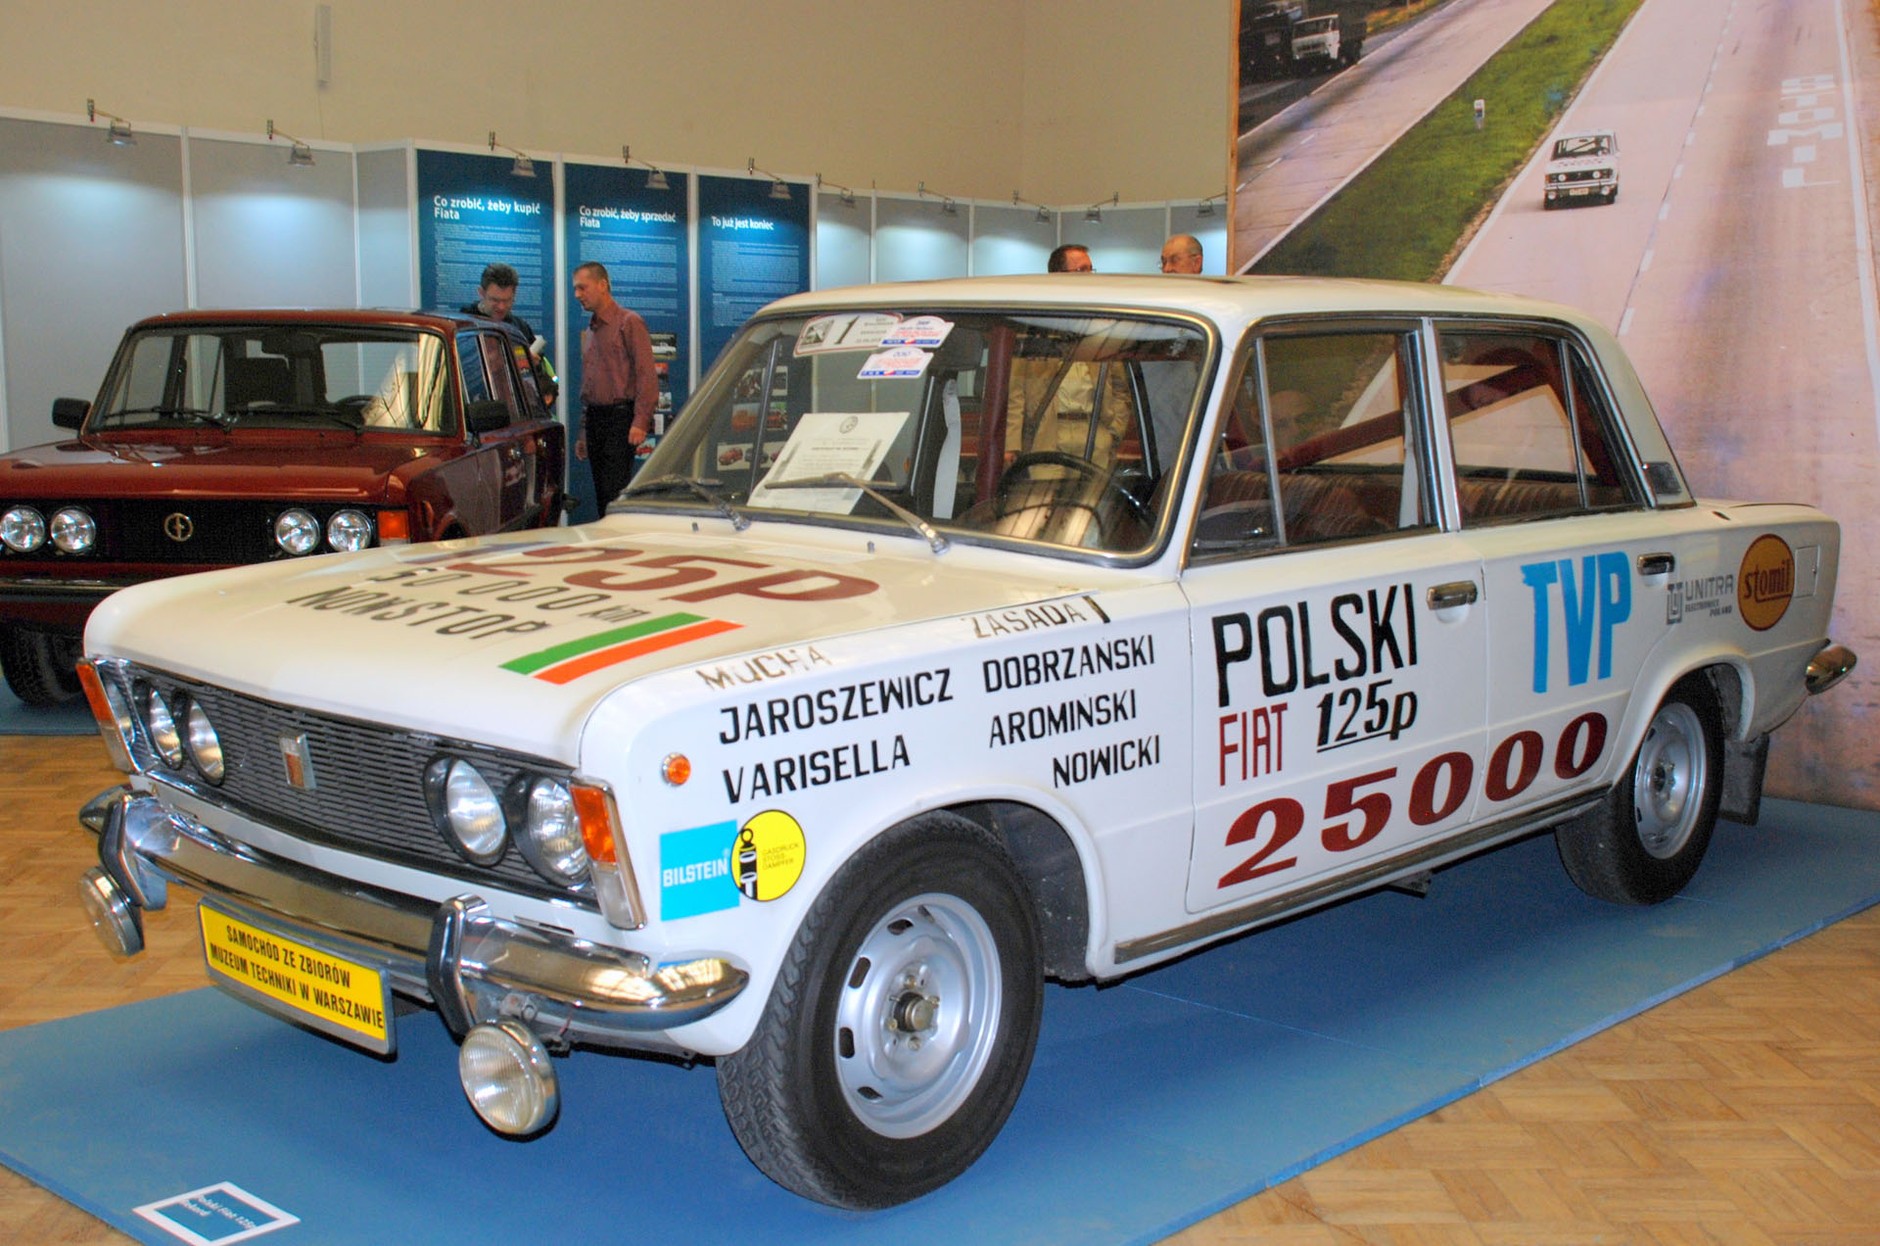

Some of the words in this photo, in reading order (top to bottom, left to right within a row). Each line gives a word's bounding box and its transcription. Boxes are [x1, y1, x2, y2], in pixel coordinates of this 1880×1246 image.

[433, 195, 448, 207] Co
[487, 200, 512, 215] żeby
[513, 201, 541, 216] kupić
[433, 206, 460, 220] Fiata
[580, 205, 591, 217] Co
[620, 208, 640, 223] żeby
[641, 211, 677, 223] sprzedać
[580, 216, 601, 229] Fiata
[711, 215, 722, 227] To
[734, 217, 749, 231] jest
[749, 217, 774, 231] koniec
[285, 586, 550, 640] NONSTOP
[1685, 574, 1734, 600] UNITRA
[968, 602, 1087, 638] ZASADA
[1212, 583, 1418, 708] POLSKI
[1520, 551, 1632, 694] TVP
[697, 645, 833, 691] MUCHA
[719, 667, 954, 745] JAROSZEWICZ
[1317, 679, 1418, 746] 125p
[722, 734, 911, 804] VARISELLA
[1053, 735, 1161, 789] NOWICKI
[1219, 702, 1288, 786] FIAT
[1217, 711, 1608, 889] 25000
[663, 857, 728, 888] BILSTEIN
[226, 924, 280, 962] SAMOCHÓD
[283, 948, 297, 969] ZE
[299, 954, 351, 989] ZBIORÓW
[210, 942, 249, 976] MUZEUM
[250, 961, 297, 996] TECHNIKI
[299, 981, 310, 1001] W
[313, 987, 385, 1030] WARSZAWIE
